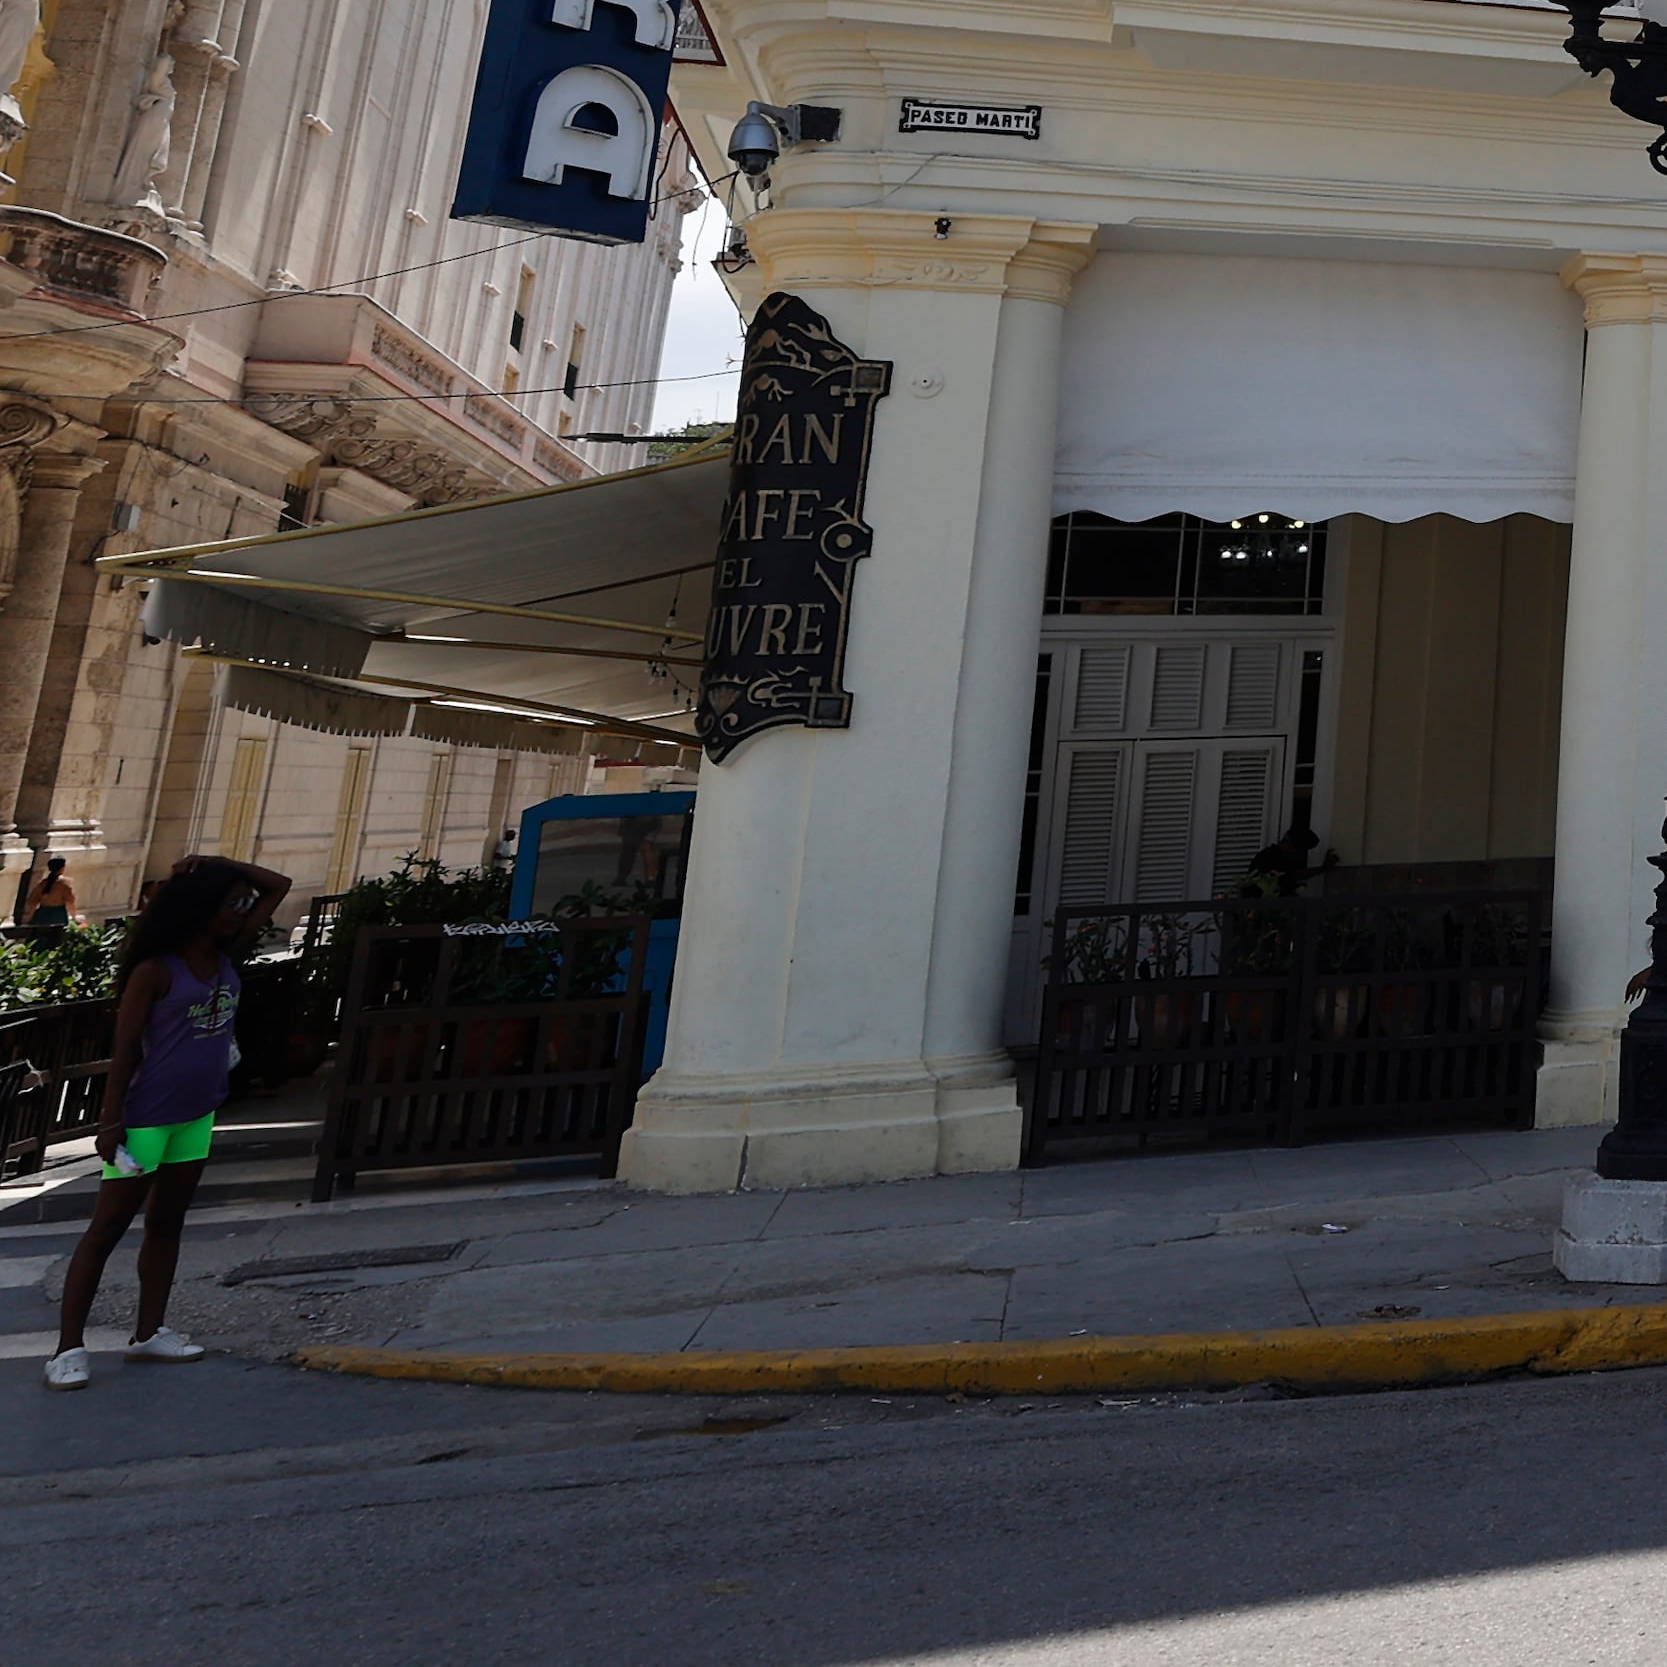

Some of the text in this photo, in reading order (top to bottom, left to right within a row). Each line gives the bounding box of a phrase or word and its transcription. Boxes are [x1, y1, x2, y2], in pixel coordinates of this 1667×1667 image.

[911, 109, 1030, 130] PASEO MARTI
[731, 412, 844, 465] RAN
[720, 488, 822, 543] AFE
[718, 556, 762, 590] EL
[706, 602, 827, 660] UVRE
